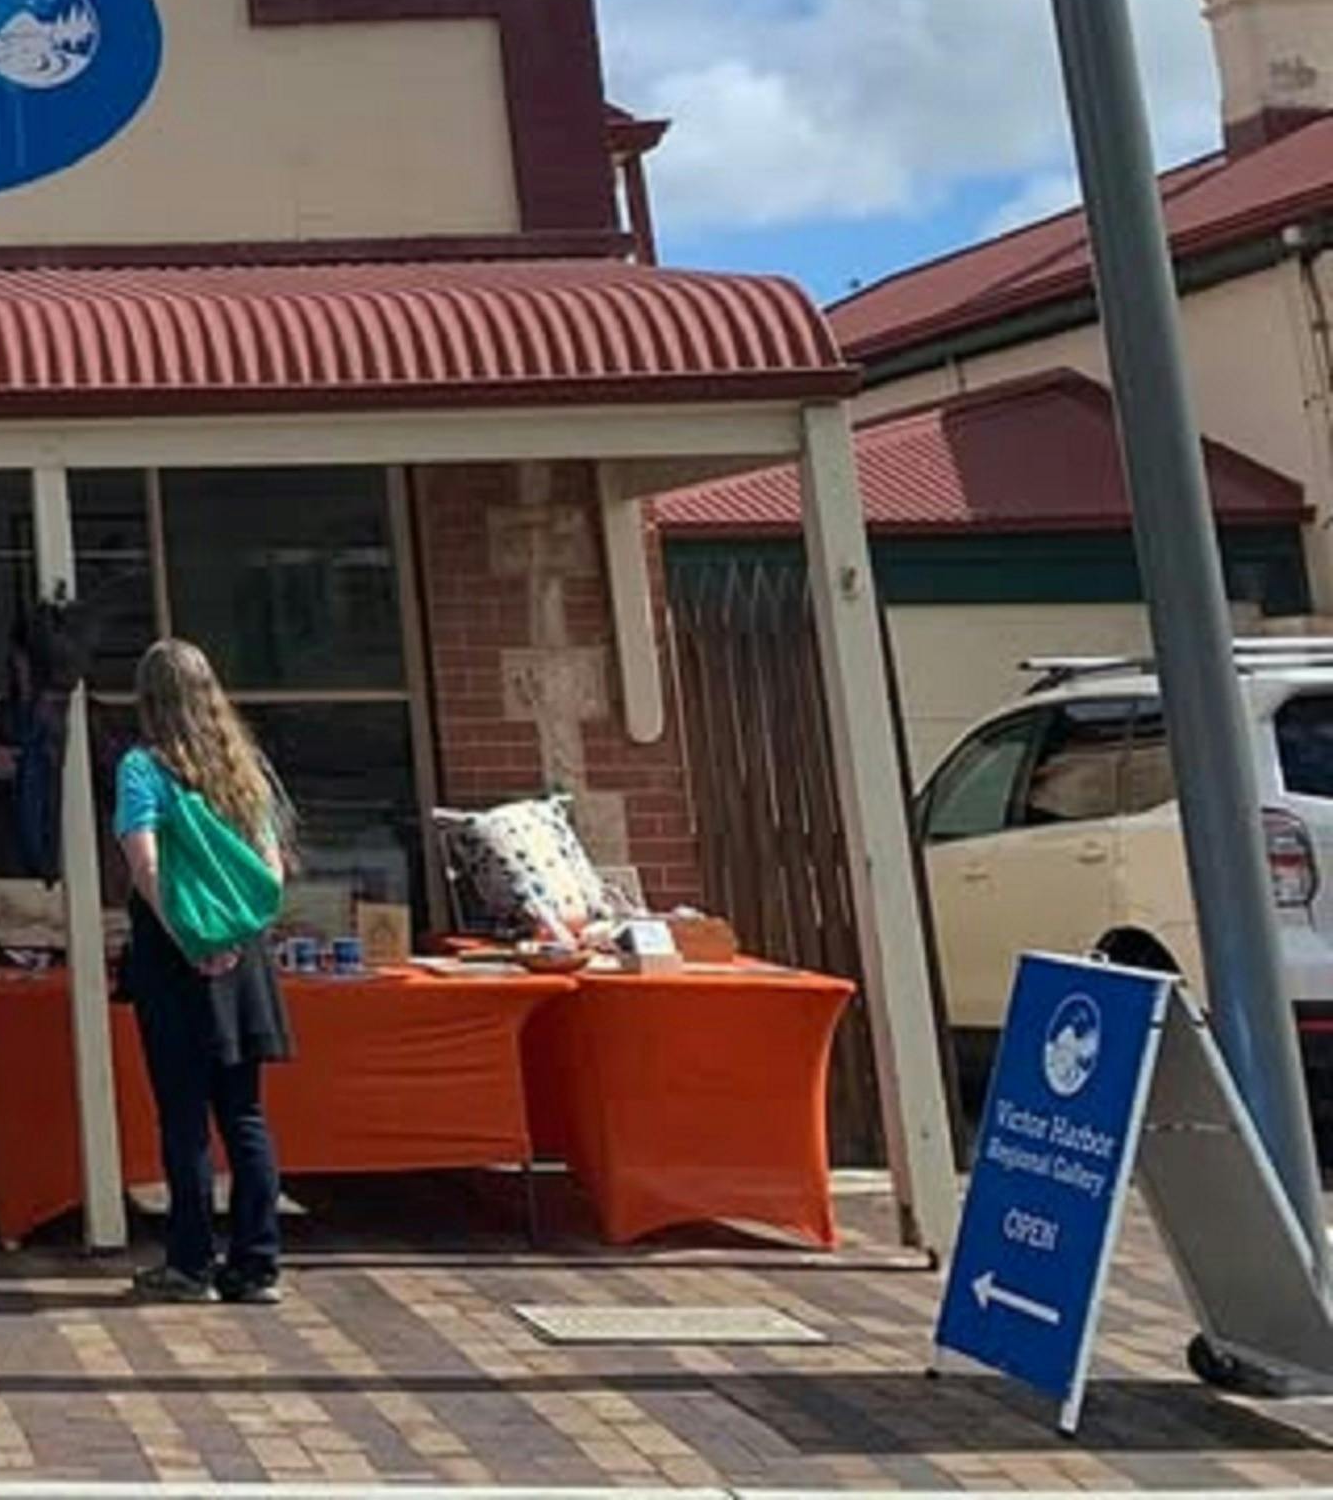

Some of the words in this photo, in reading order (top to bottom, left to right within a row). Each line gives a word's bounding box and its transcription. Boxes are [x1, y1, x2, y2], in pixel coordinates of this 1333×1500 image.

[996, 1099, 1050, 1138] Victor
[1049, 1114, 1116, 1159] Harbor
[986, 1136, 1051, 1175] Regional
[1052, 1155, 1107, 1198] Gallery
[1002, 1207, 1060, 1252] OPEN
